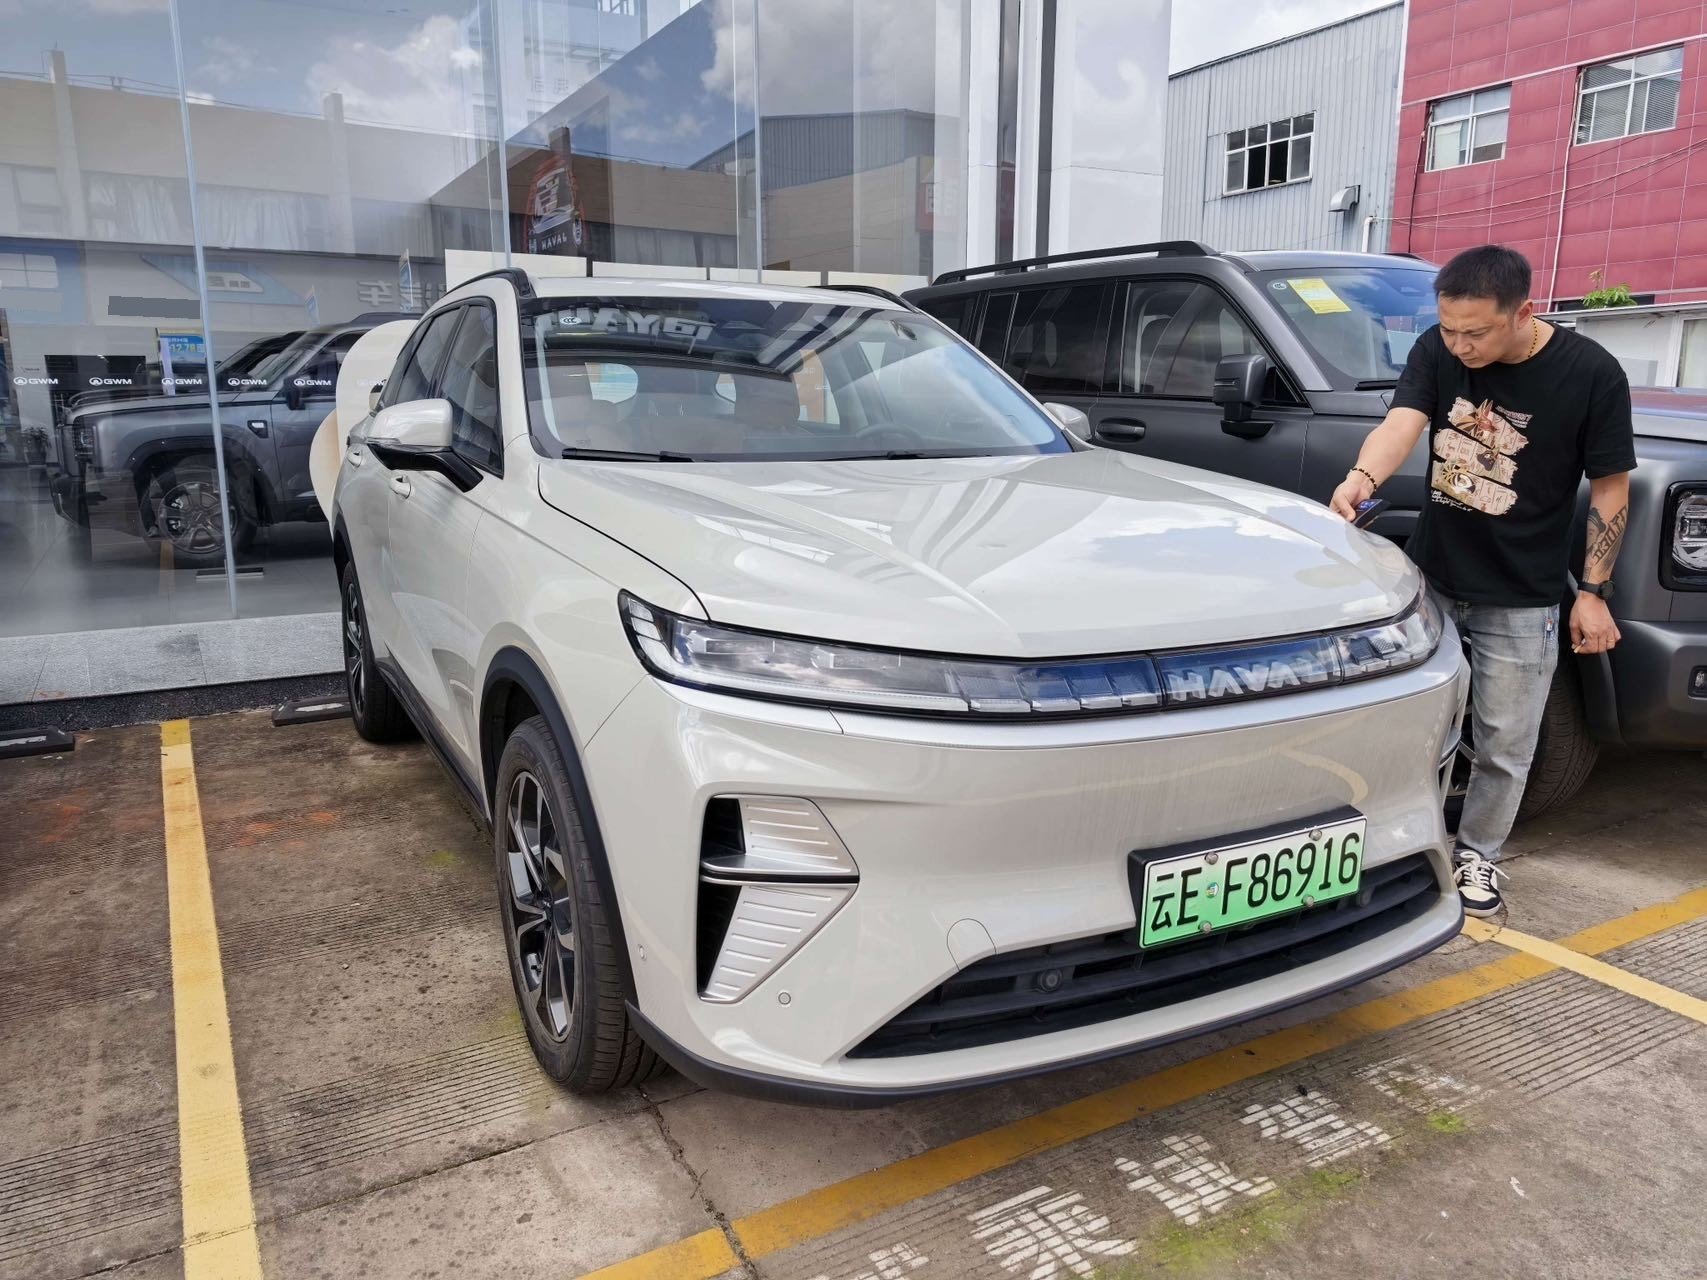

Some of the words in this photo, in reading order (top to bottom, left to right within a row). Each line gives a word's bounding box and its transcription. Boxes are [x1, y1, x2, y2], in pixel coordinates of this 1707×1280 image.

[541, 232, 568, 251] HAVAL
[175, 378, 203, 386] GWM
[1167, 657, 1329, 702] HAVAL
